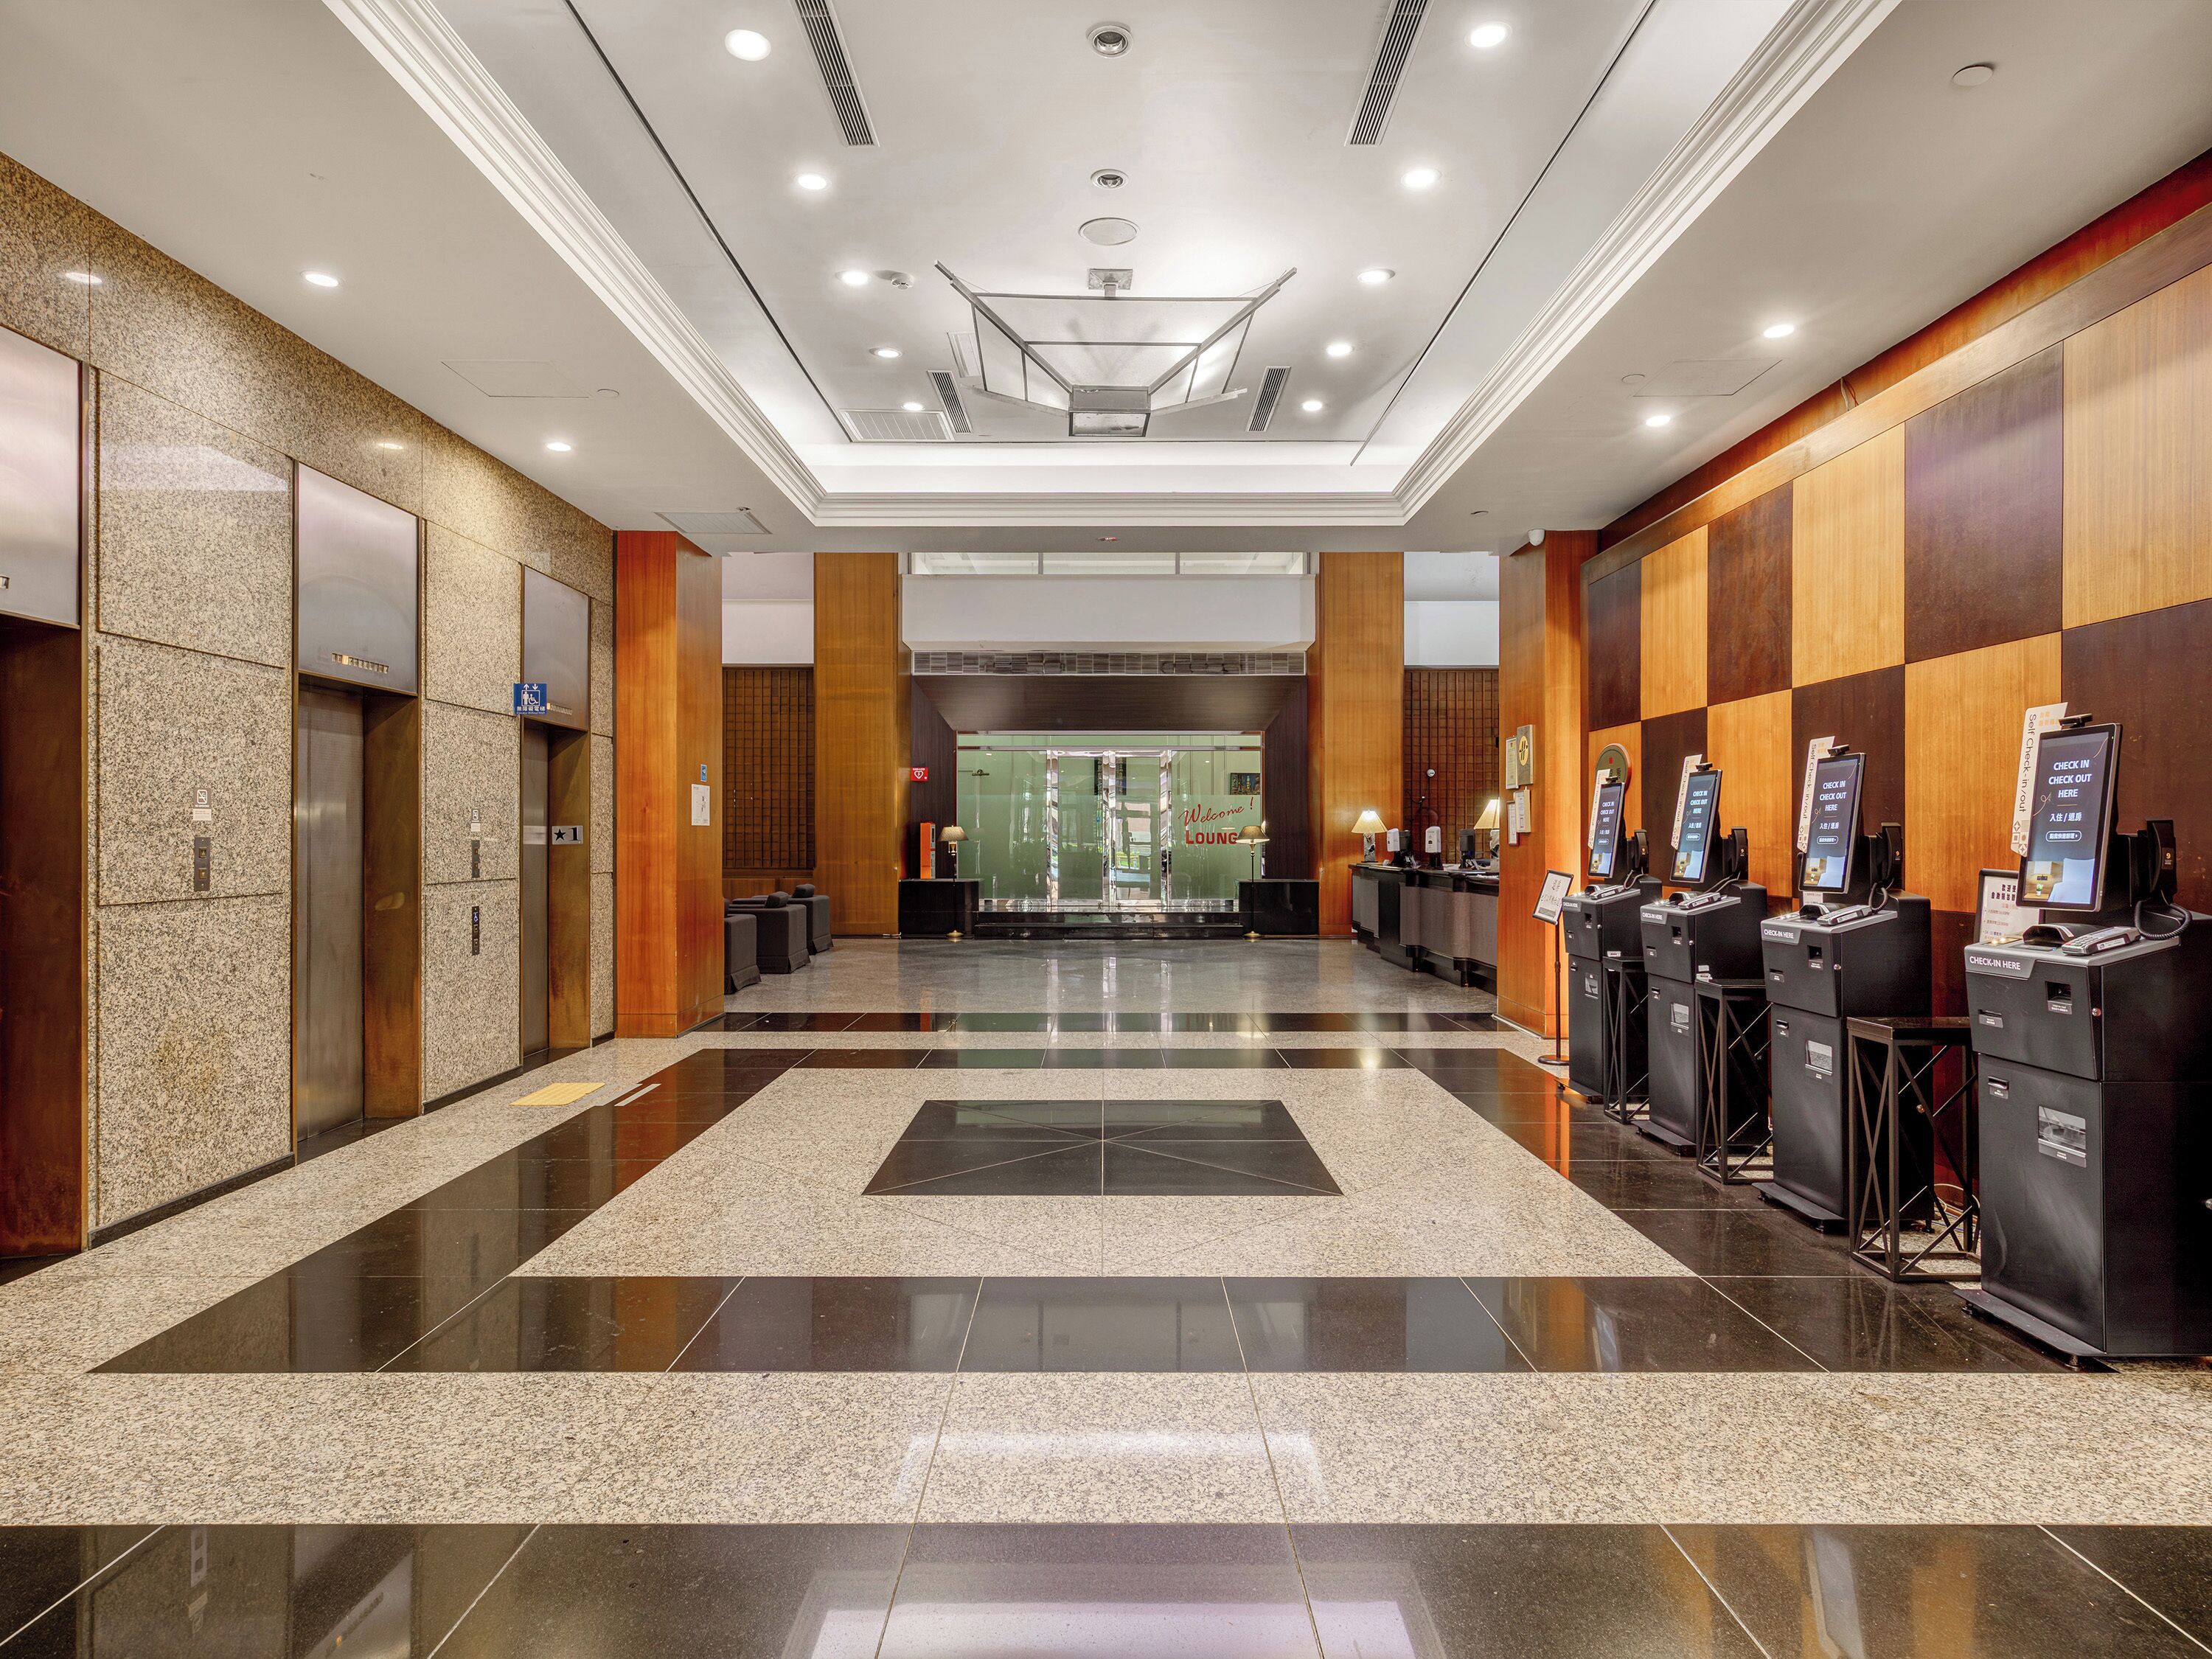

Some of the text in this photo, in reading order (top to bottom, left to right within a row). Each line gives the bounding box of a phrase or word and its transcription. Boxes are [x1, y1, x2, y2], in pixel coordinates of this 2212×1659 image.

[2028, 714, 2037, 735] Self
[2053, 759, 2090, 771] CHECK IN
[2048, 773, 2092, 785] CHECK OUT
[1823, 782, 1839, 790] CHECK
[1819, 793, 1834, 801] CHECK
[2058, 789, 2079, 798] HERE
[568, 827, 581, 841] 1
[1186, 830, 1238, 844] LOUNG
[1764, 929, 1783, 937] CHECK-IN
[1969, 956, 2020, 970] CHECK-IN HERE
